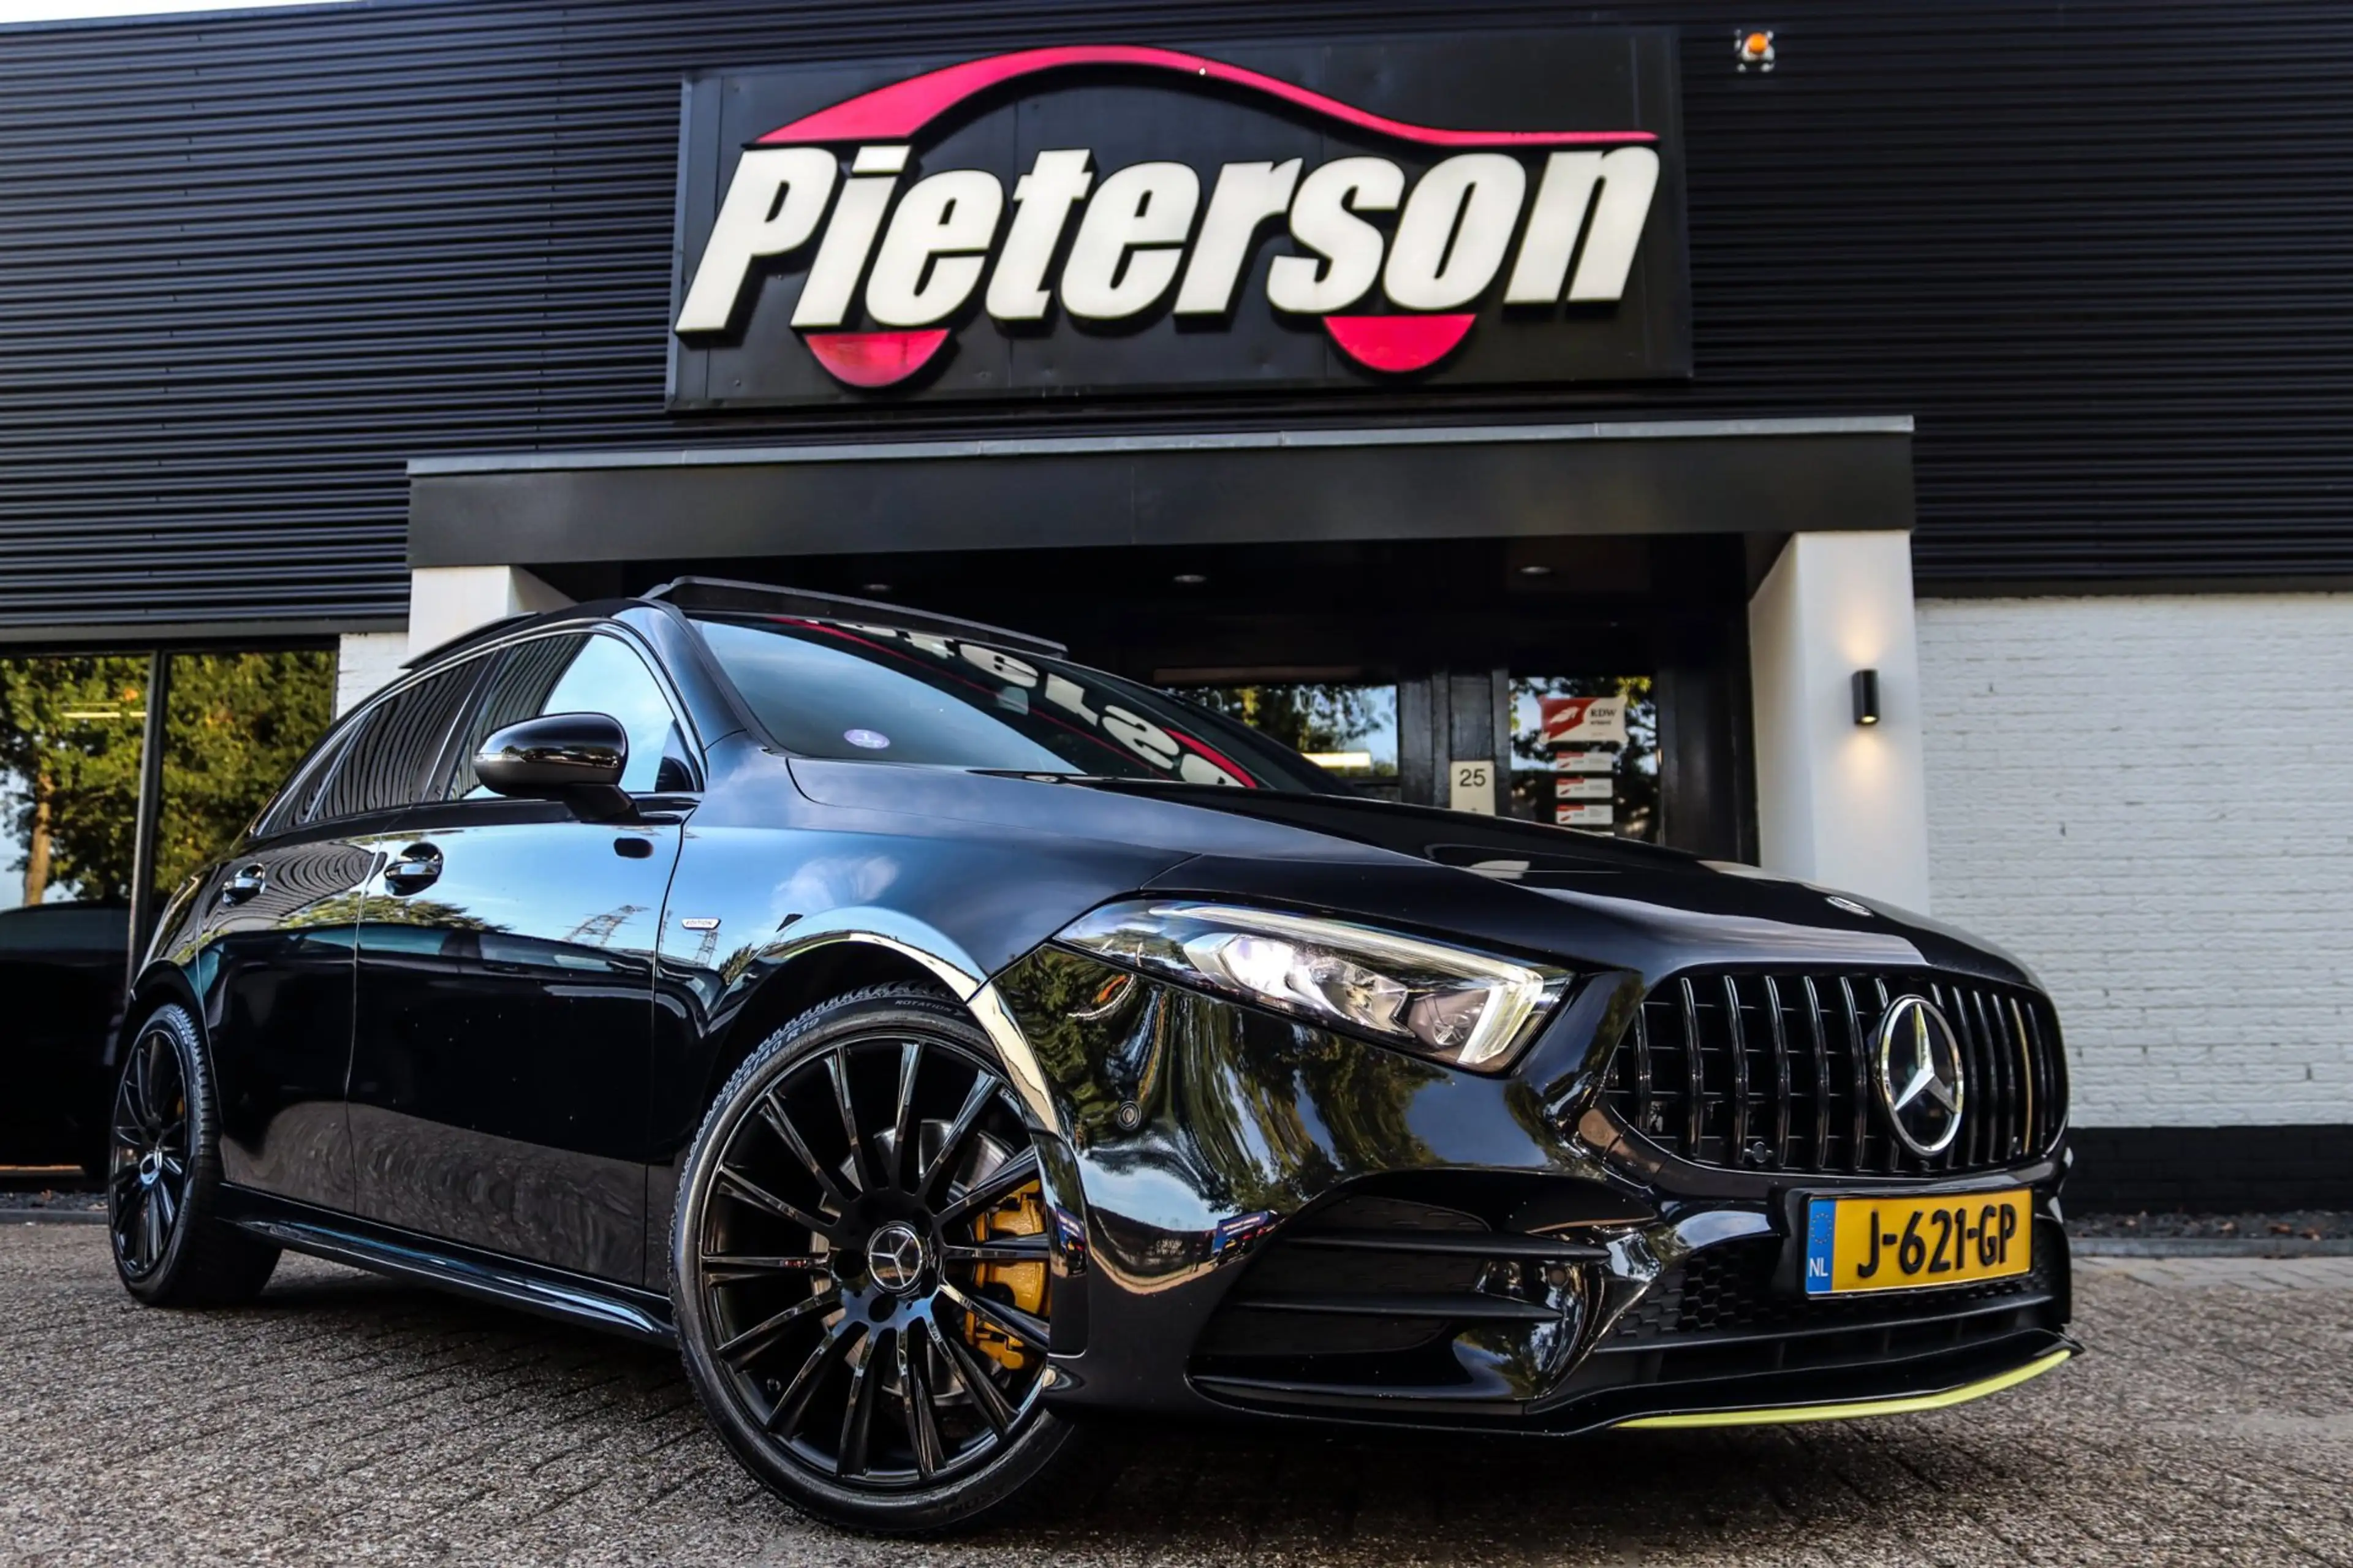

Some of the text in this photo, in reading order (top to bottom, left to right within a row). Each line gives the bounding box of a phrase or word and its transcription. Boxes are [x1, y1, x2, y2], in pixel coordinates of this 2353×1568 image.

[675, 145, 1659, 332] Pieterson
[1460, 768, 1487, 787] 25
[895, 999, 953, 1012] ROTATION
[1857, 1203, 2017, 1278] J-621-GP
[1809, 1257, 1828, 1278] NL
